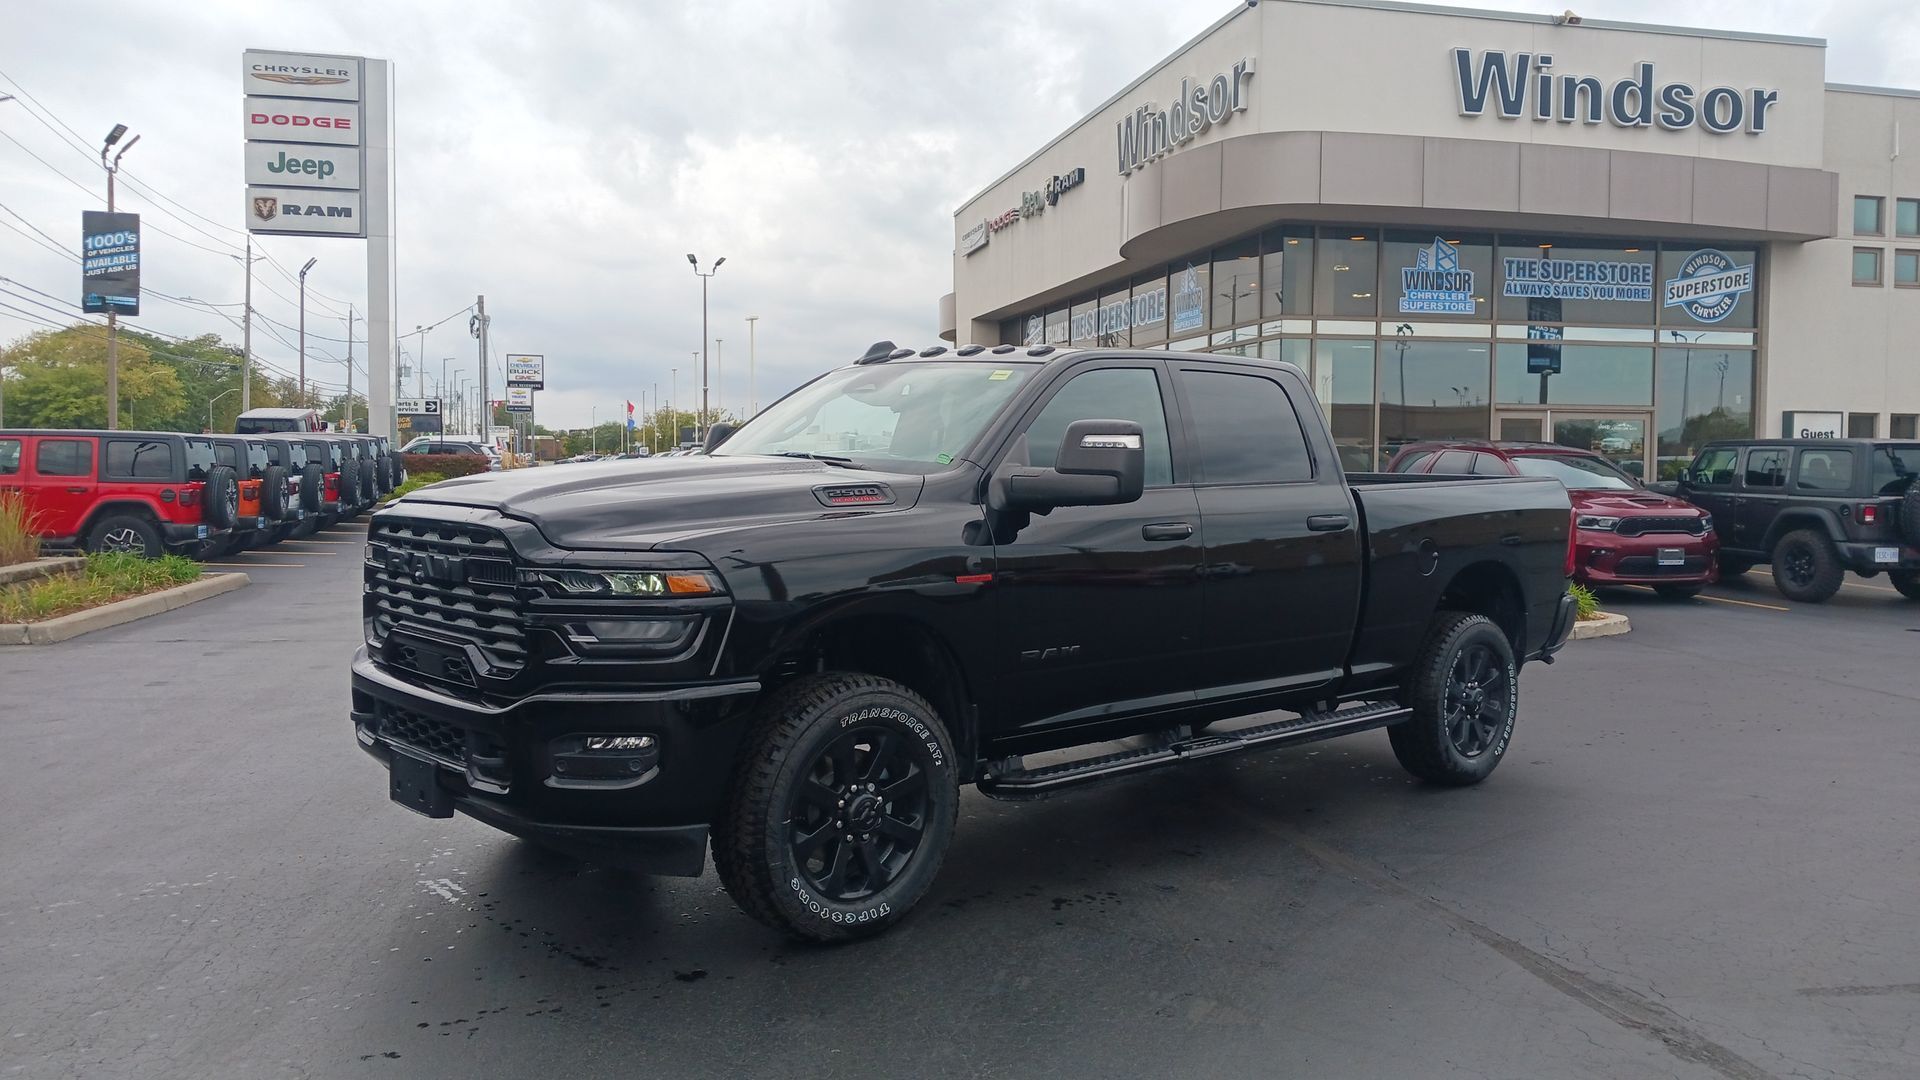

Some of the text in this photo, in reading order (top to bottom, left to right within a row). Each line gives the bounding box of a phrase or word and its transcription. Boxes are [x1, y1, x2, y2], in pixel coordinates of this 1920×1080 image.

[252, 64, 348, 77] CHRYSLER
[1450, 46, 1779, 135] Windsor
[251, 114, 351, 129] DODGE
[1116, 56, 1255, 176] Windsor
[267, 152, 334, 179] Jeep
[1054, 168, 1085, 194] RAM
[282, 204, 352, 218] RAM
[1020, 190, 1045, 217] Jeep
[988, 208, 1020, 232] DODGE
[85, 231, 137, 249] 1000's
[962, 223, 984, 241] CHRYSLER
[99, 245, 135, 255] VEHICLES
[86, 254, 138, 269] AVAILABLE
[86, 268, 105, 276] JUST
[107, 265, 124, 273] ASK
[1505, 259, 1651, 282] THE SUPERSTORE
[1685, 254, 1727, 275] WINDSOR
[1404, 271, 1471, 292] WINDSOR
[1506, 283, 1651, 299] ALWAYS SAVES YOU MORE!
[1669, 272, 1749, 300] SUPERSTORE
[1410, 291, 1465, 300] CHRYSLER
[1072, 314, 1085, 342] THE
[1085, 289, 1166, 339] SUPERSTORE
[1402, 302, 1472, 311] SUPERSTORE
[1692, 297, 1733, 318] CHRYSLER
[1175, 317, 1202, 329] SUPERSTORE
[1800, 429, 1834, 439] Guest
[829, 487, 879, 497] 2500
[385, 547, 465, 581] RAM
[840, 707, 929, 739] TRANSFORCE
